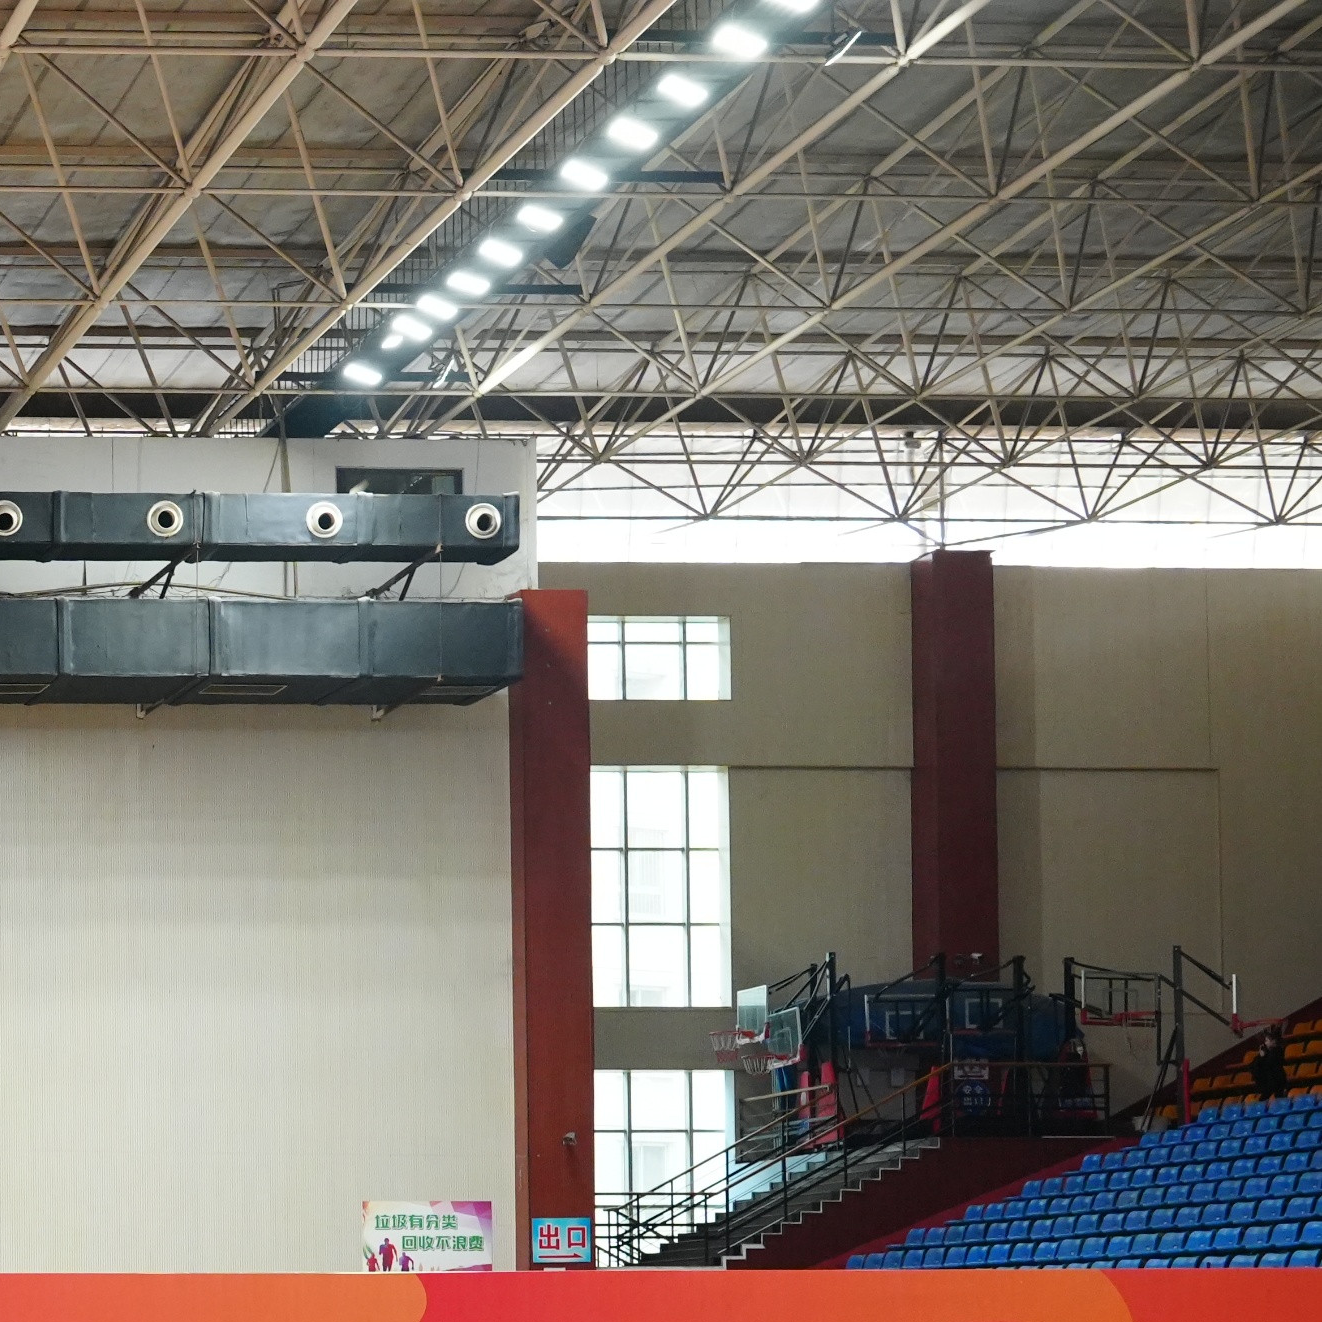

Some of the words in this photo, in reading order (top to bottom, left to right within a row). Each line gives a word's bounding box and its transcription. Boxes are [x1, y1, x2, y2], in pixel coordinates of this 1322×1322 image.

[375, 1214, 458, 1230] 垃圾有分类
[402, 1236, 484, 1250] 回收不浪费
[538, 1223, 588, 1250] 出口
